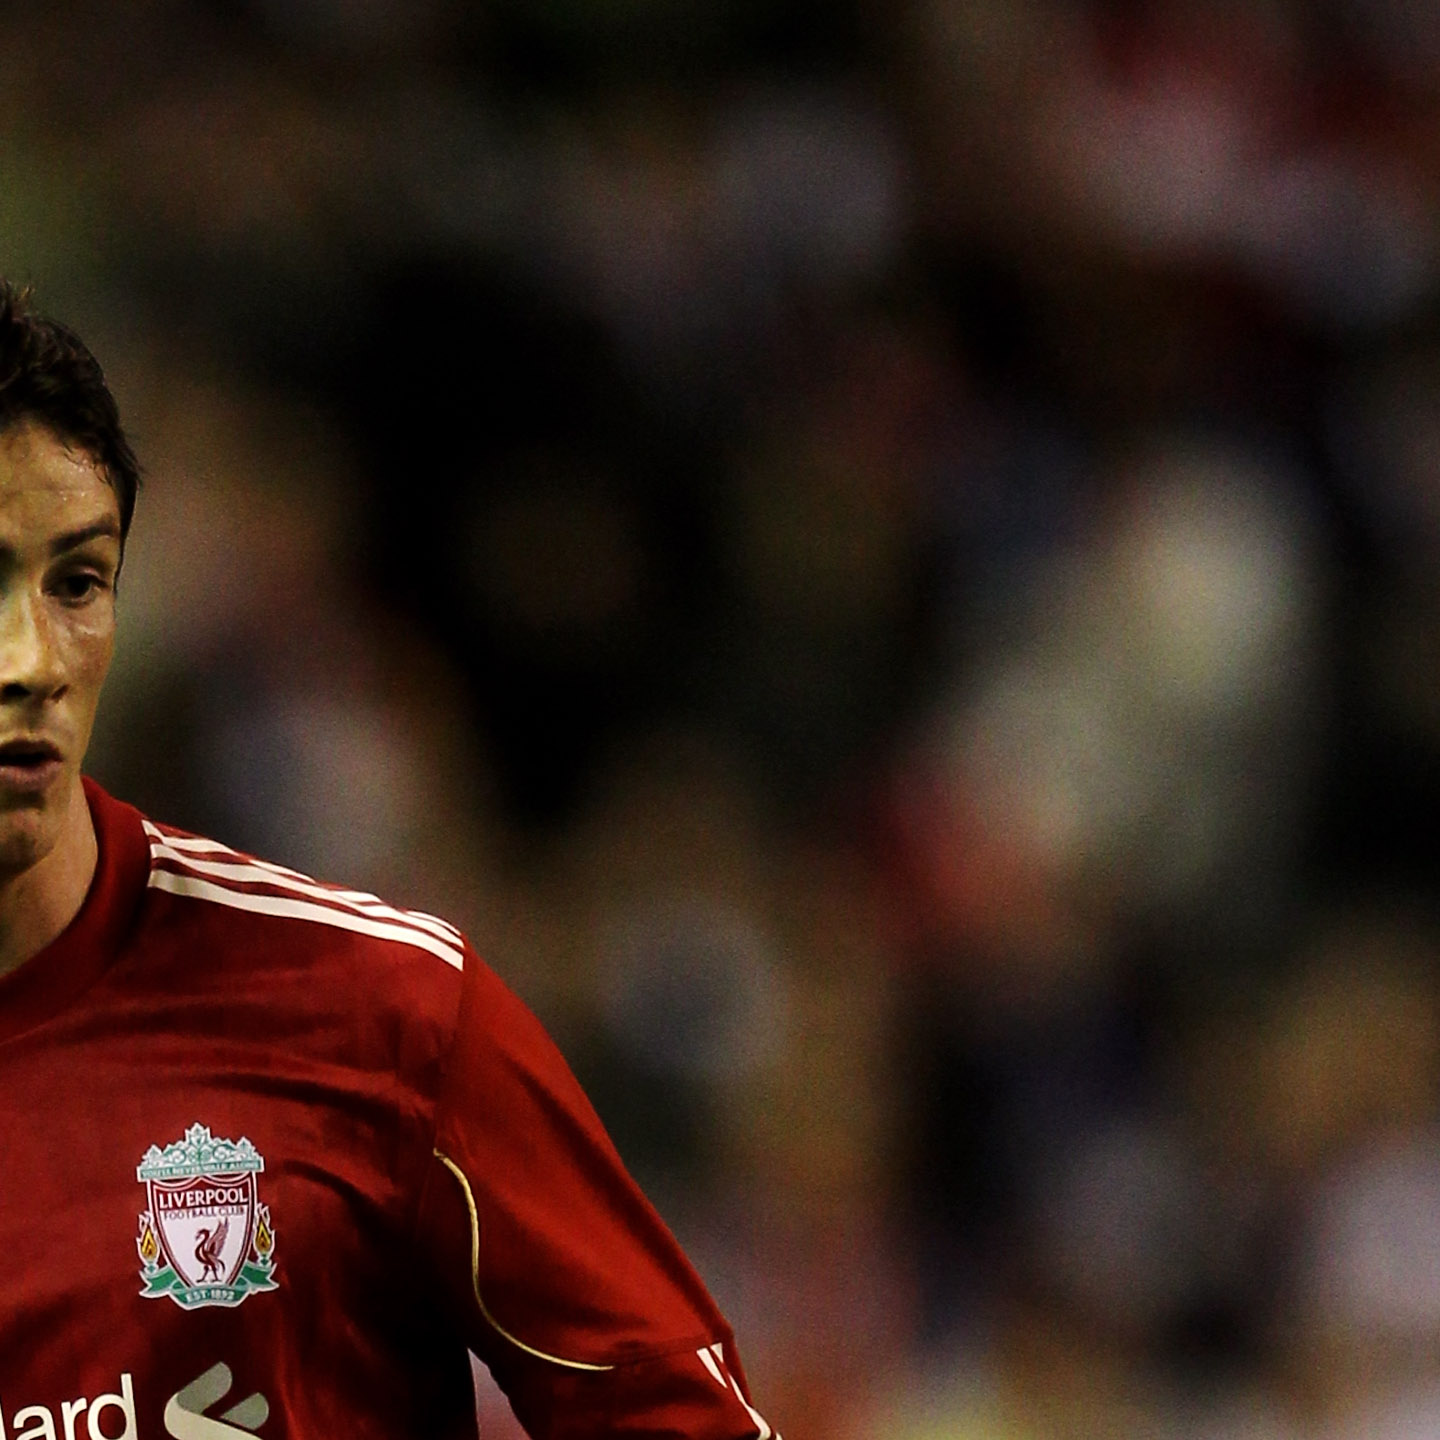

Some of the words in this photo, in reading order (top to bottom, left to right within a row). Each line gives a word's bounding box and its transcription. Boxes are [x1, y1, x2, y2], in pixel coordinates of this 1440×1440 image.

[158, 1187, 249, 1209] LIVERPOOL
[163, 1207, 217, 1220] FOOTBALL
[218, 1205, 245, 1216] CLUB
